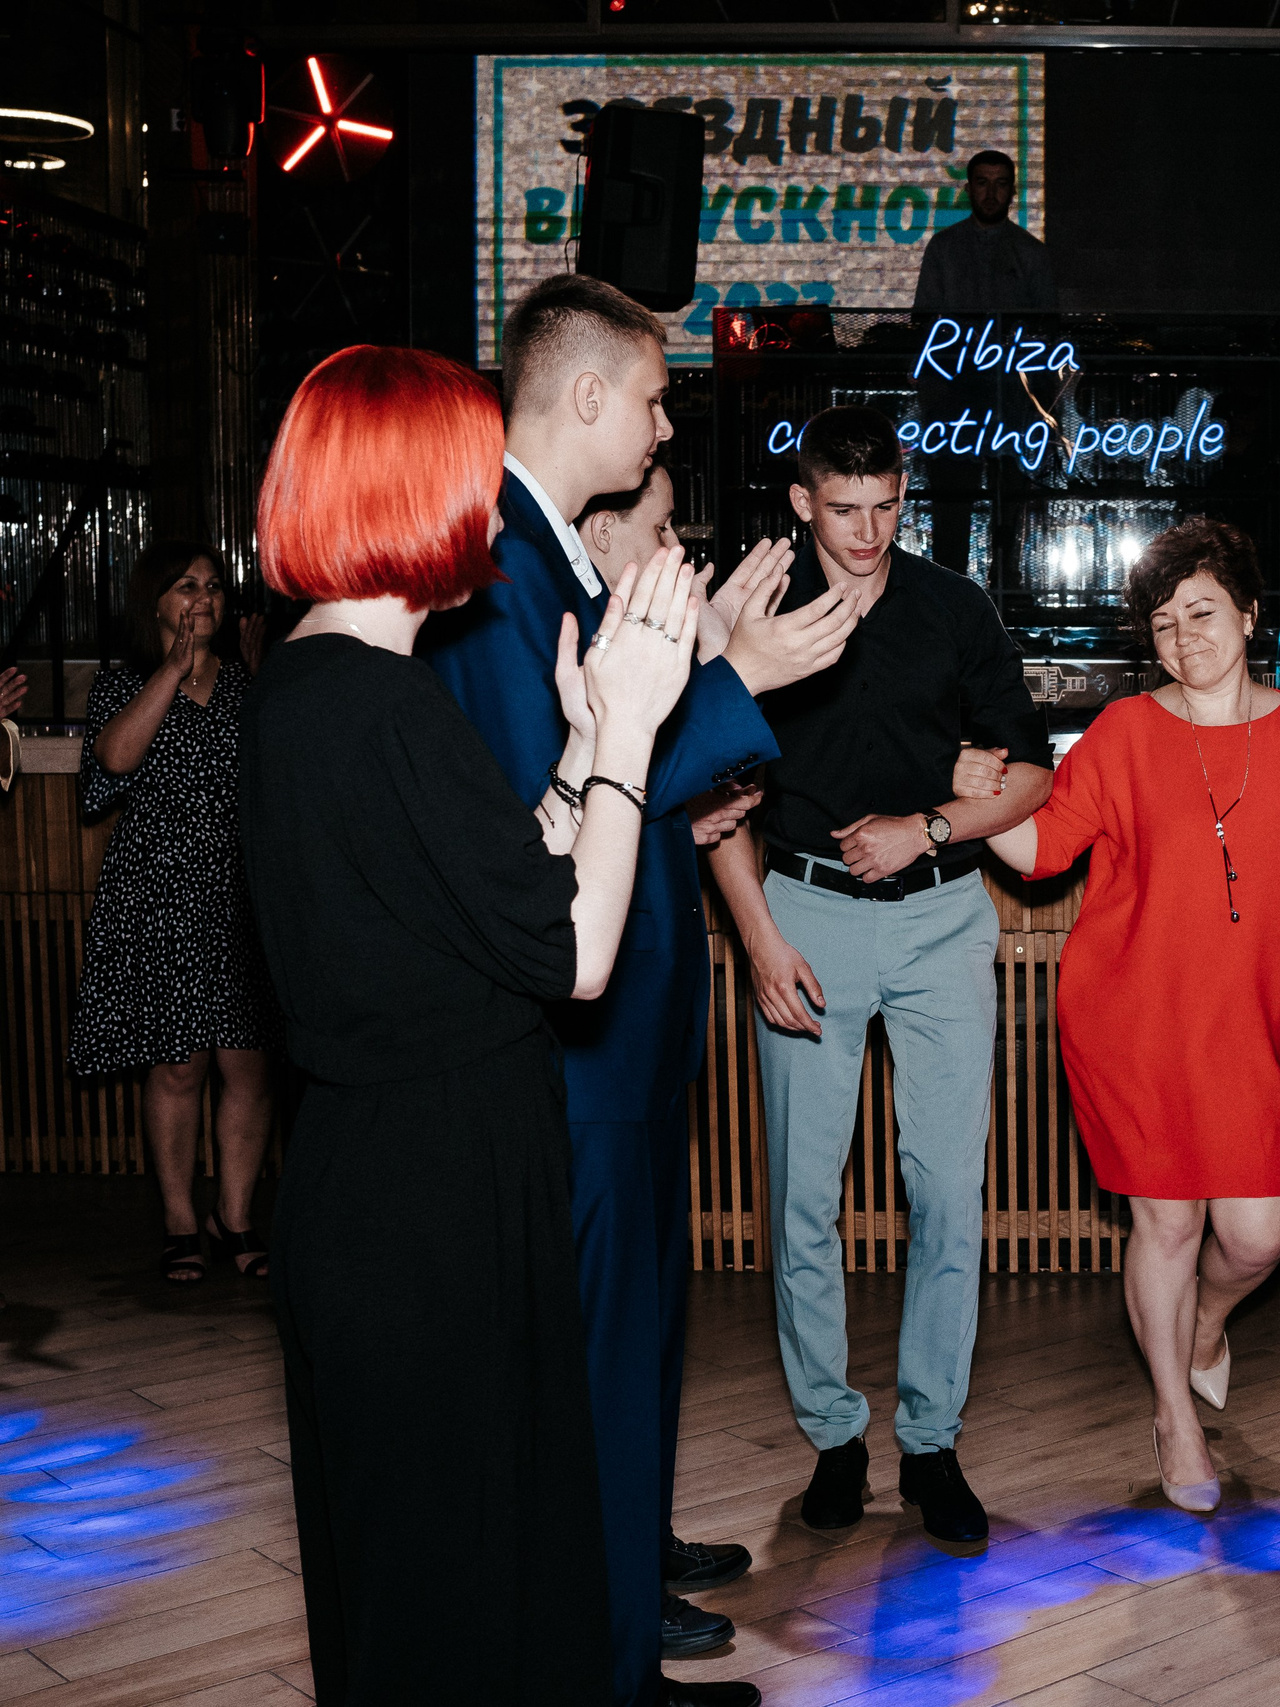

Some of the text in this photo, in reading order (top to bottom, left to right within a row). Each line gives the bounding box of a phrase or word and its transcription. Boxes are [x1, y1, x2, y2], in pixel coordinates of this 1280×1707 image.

[560, 76, 958, 166] ЗЗДНЫЙ
[525, 165, 972, 245] ВУСКНОЙ
[913, 318, 1080, 380] Ribiza
[767, 400, 1225, 474] cecting people
